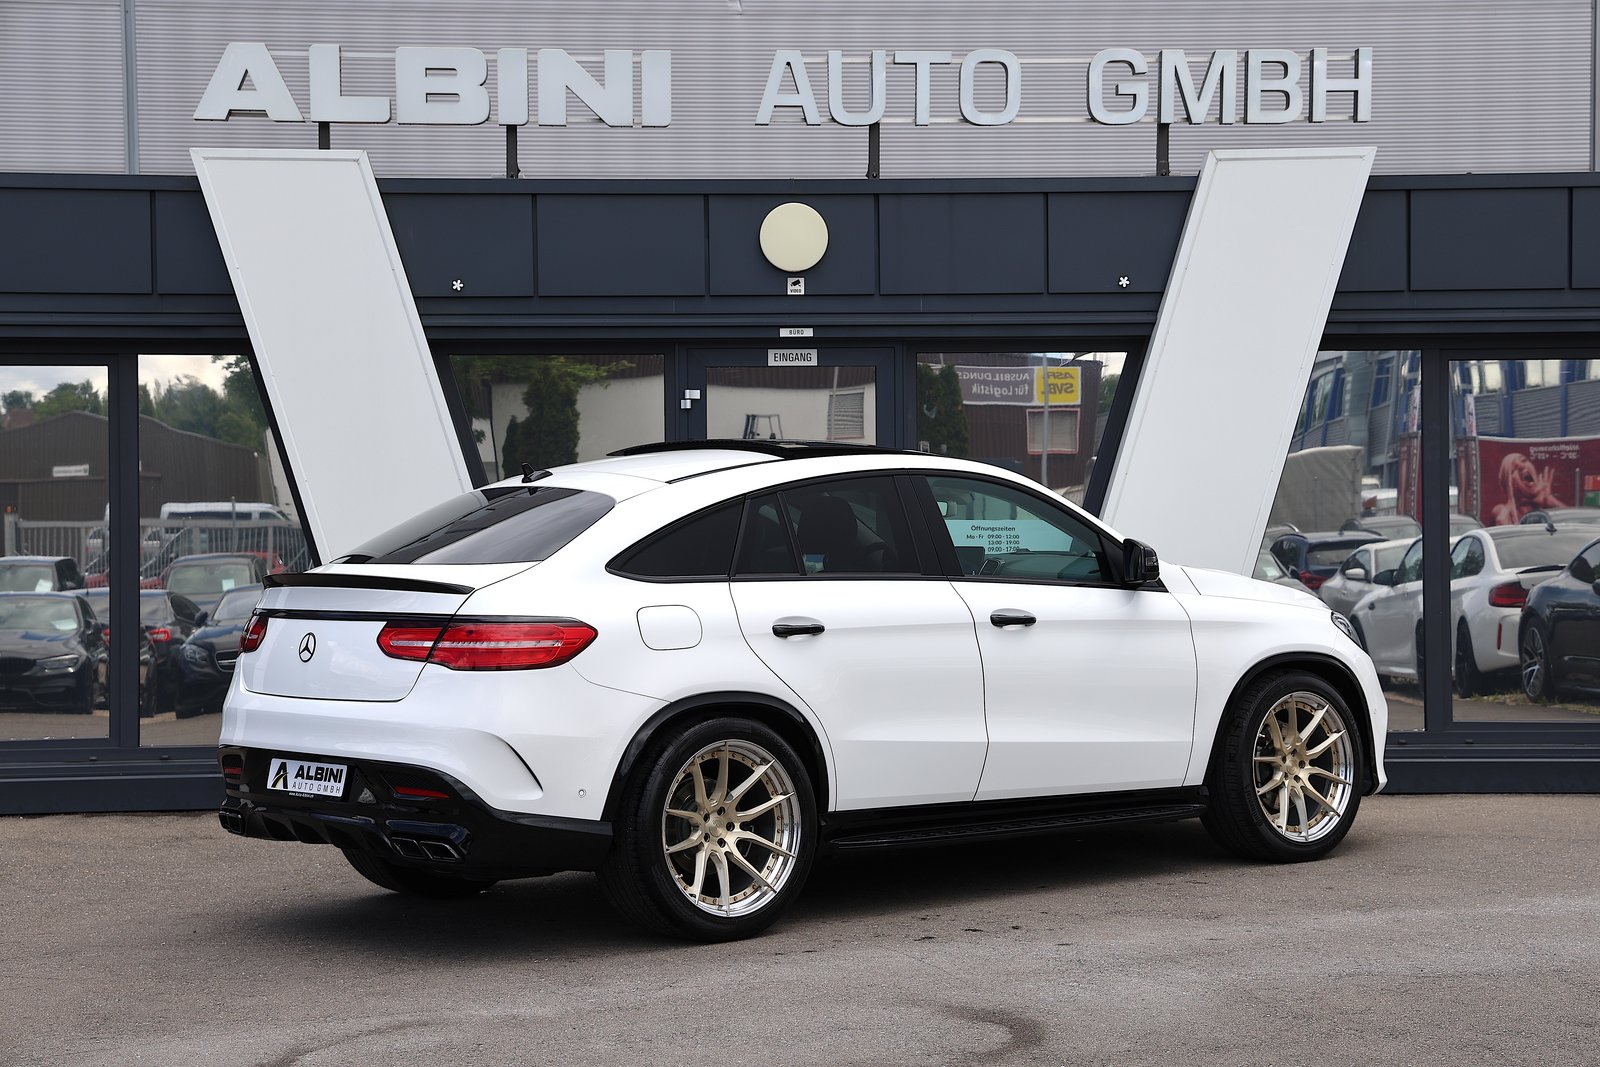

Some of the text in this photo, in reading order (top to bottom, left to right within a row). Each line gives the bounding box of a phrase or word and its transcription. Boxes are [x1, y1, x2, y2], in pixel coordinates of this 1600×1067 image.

[193, 42, 1373, 128] ALBINI AUTO GMBH
[773, 352, 812, 362] EINGANG
[294, 765, 344, 784] ALBINI
[292, 781, 341, 794] AUTO GMBH
